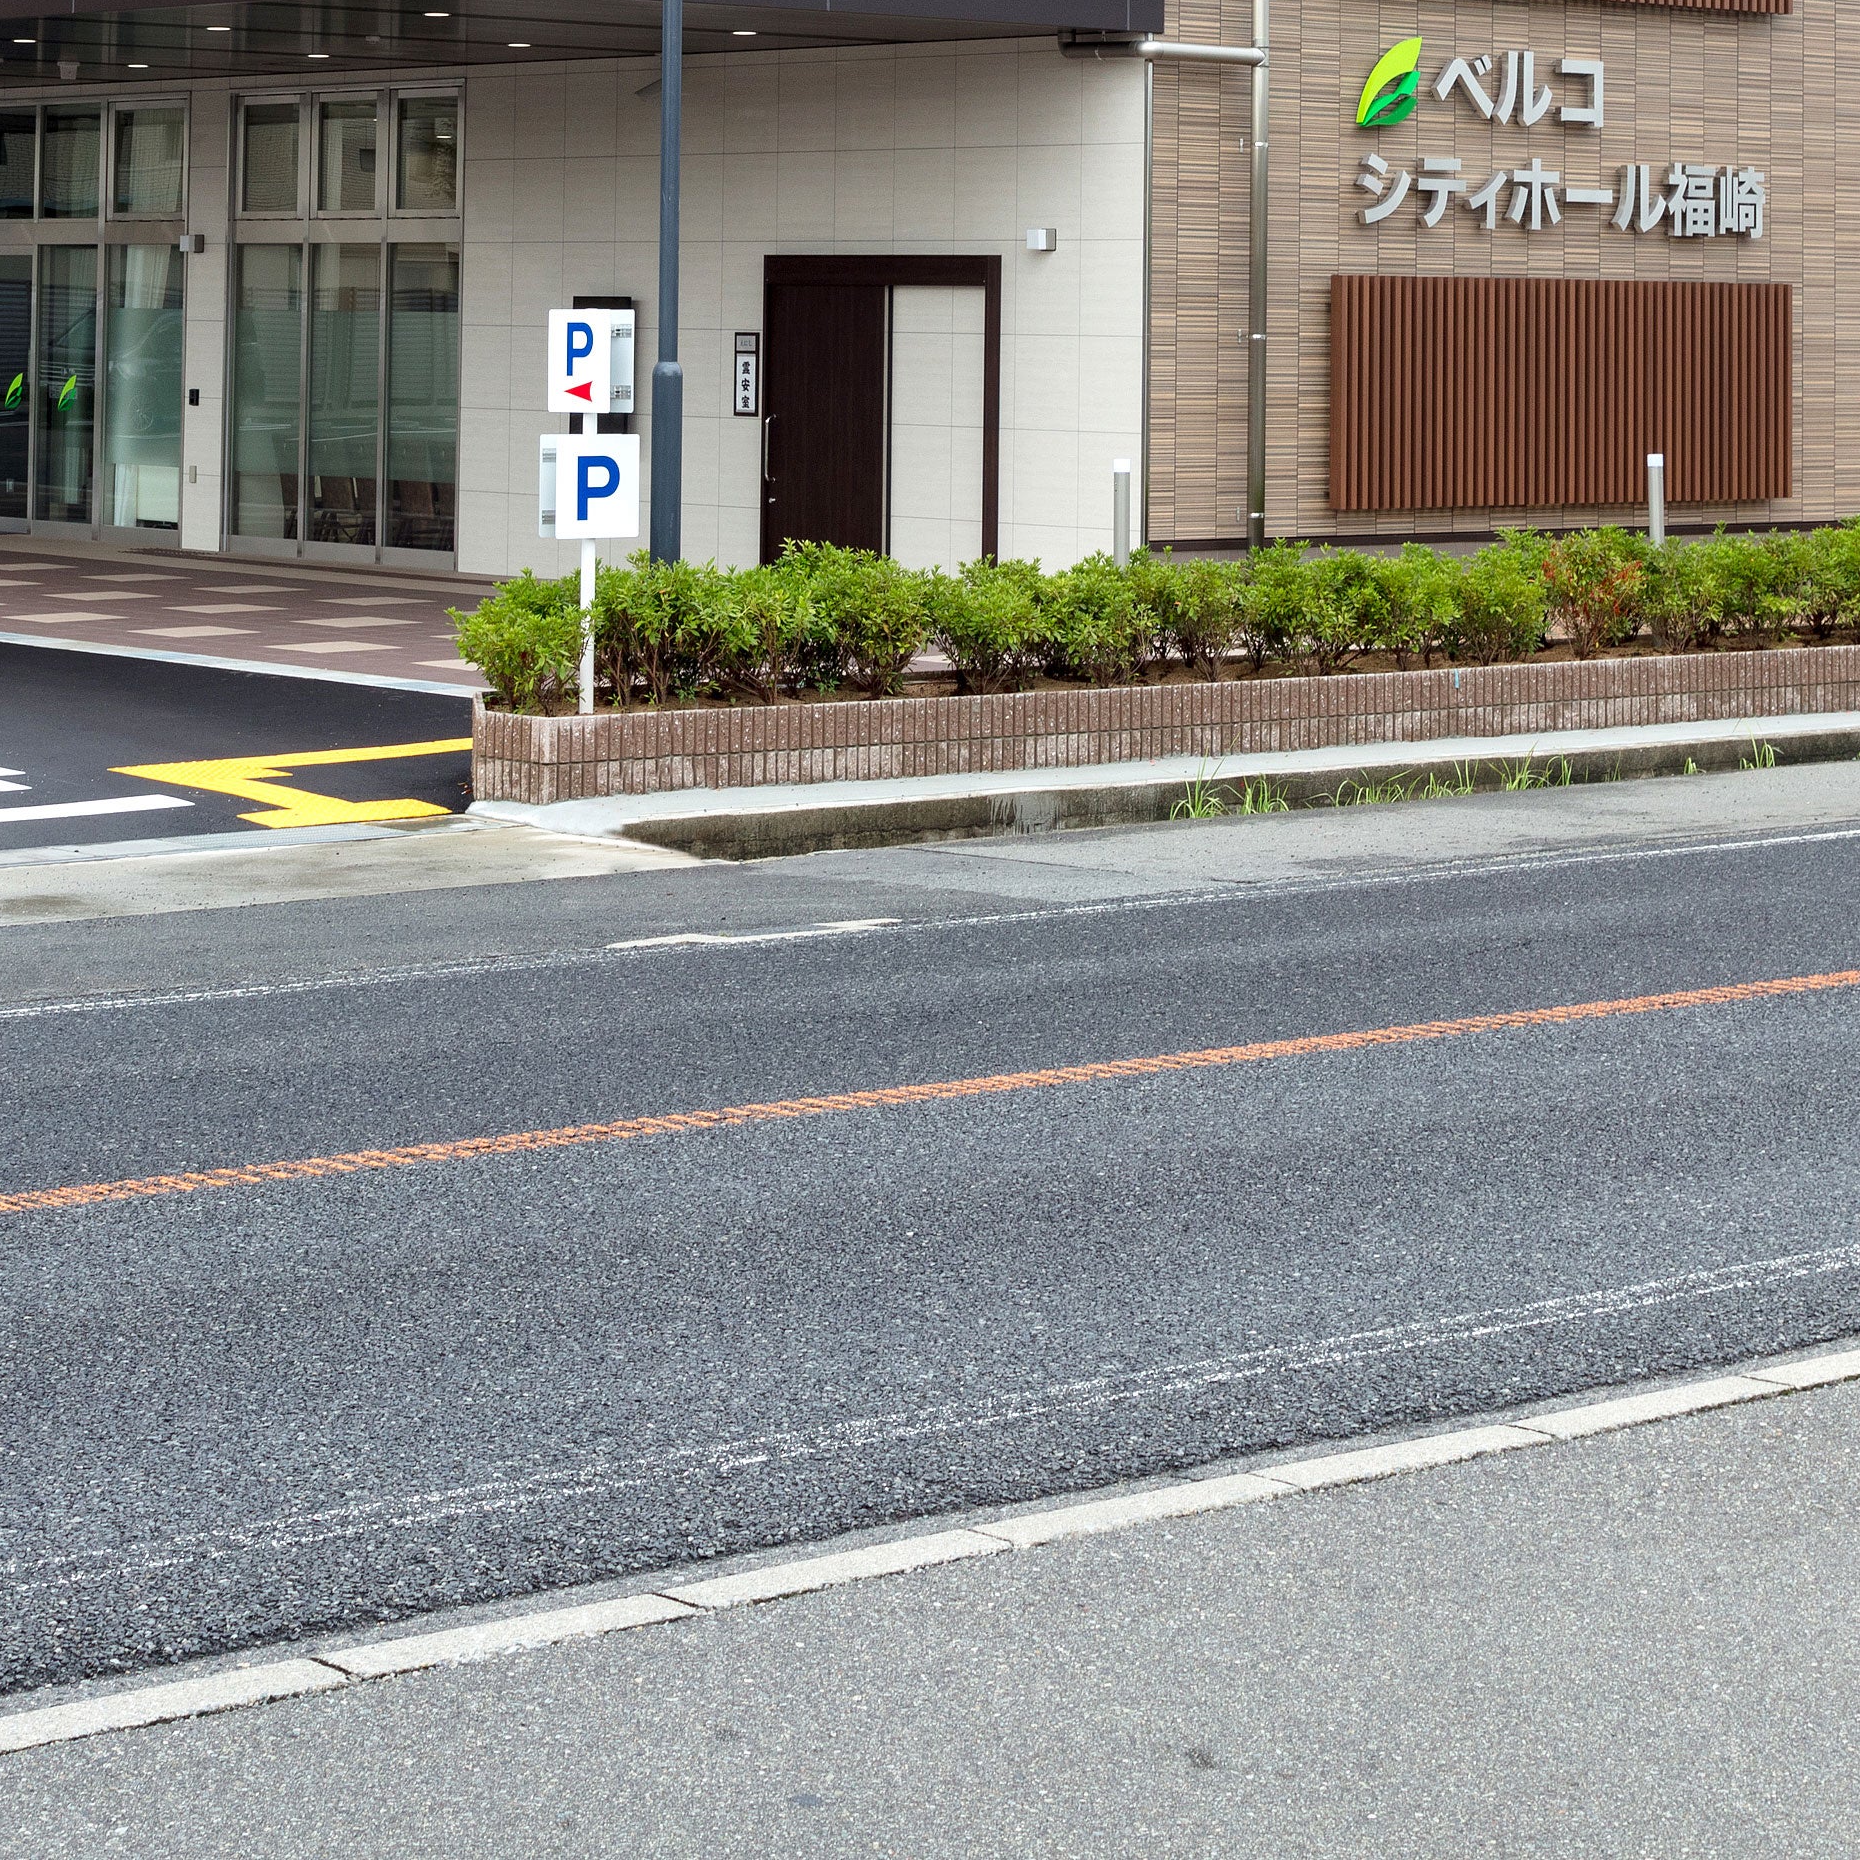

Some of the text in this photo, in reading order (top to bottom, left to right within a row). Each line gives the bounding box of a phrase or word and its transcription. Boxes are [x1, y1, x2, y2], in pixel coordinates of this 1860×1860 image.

[1432, 50, 1604, 128] ベルコ
[1357, 152, 1766, 238] シティホール福崎
[566, 322, 594, 376] P
[741, 361, 751, 409] 霊安室
[576, 455, 621, 521] P
